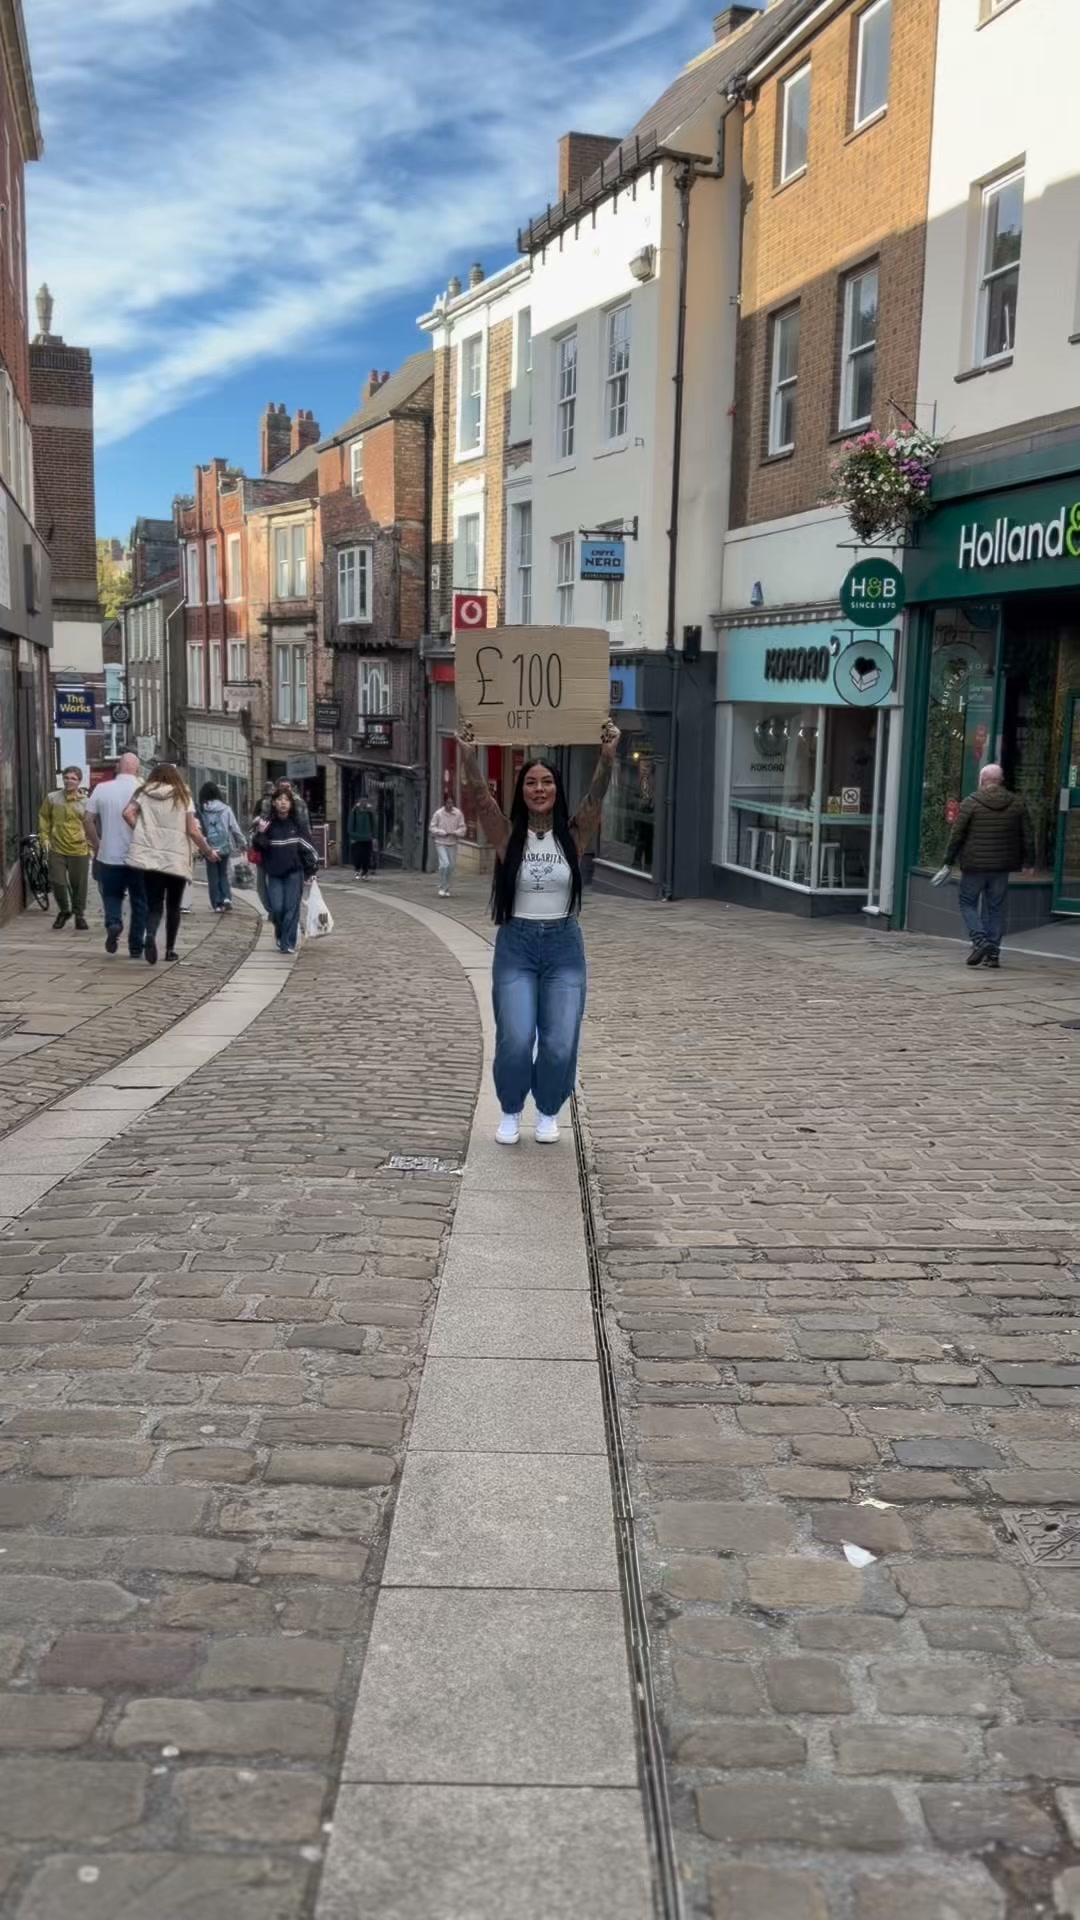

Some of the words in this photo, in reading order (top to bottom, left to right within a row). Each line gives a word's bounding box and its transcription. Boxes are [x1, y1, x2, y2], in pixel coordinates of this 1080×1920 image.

[585, 557, 621, 567] NERO
[851, 577, 896, 598] H&B
[66, 694, 85, 703] The
[60, 703, 92, 713] Works
[507, 709, 535, 729] OFF
